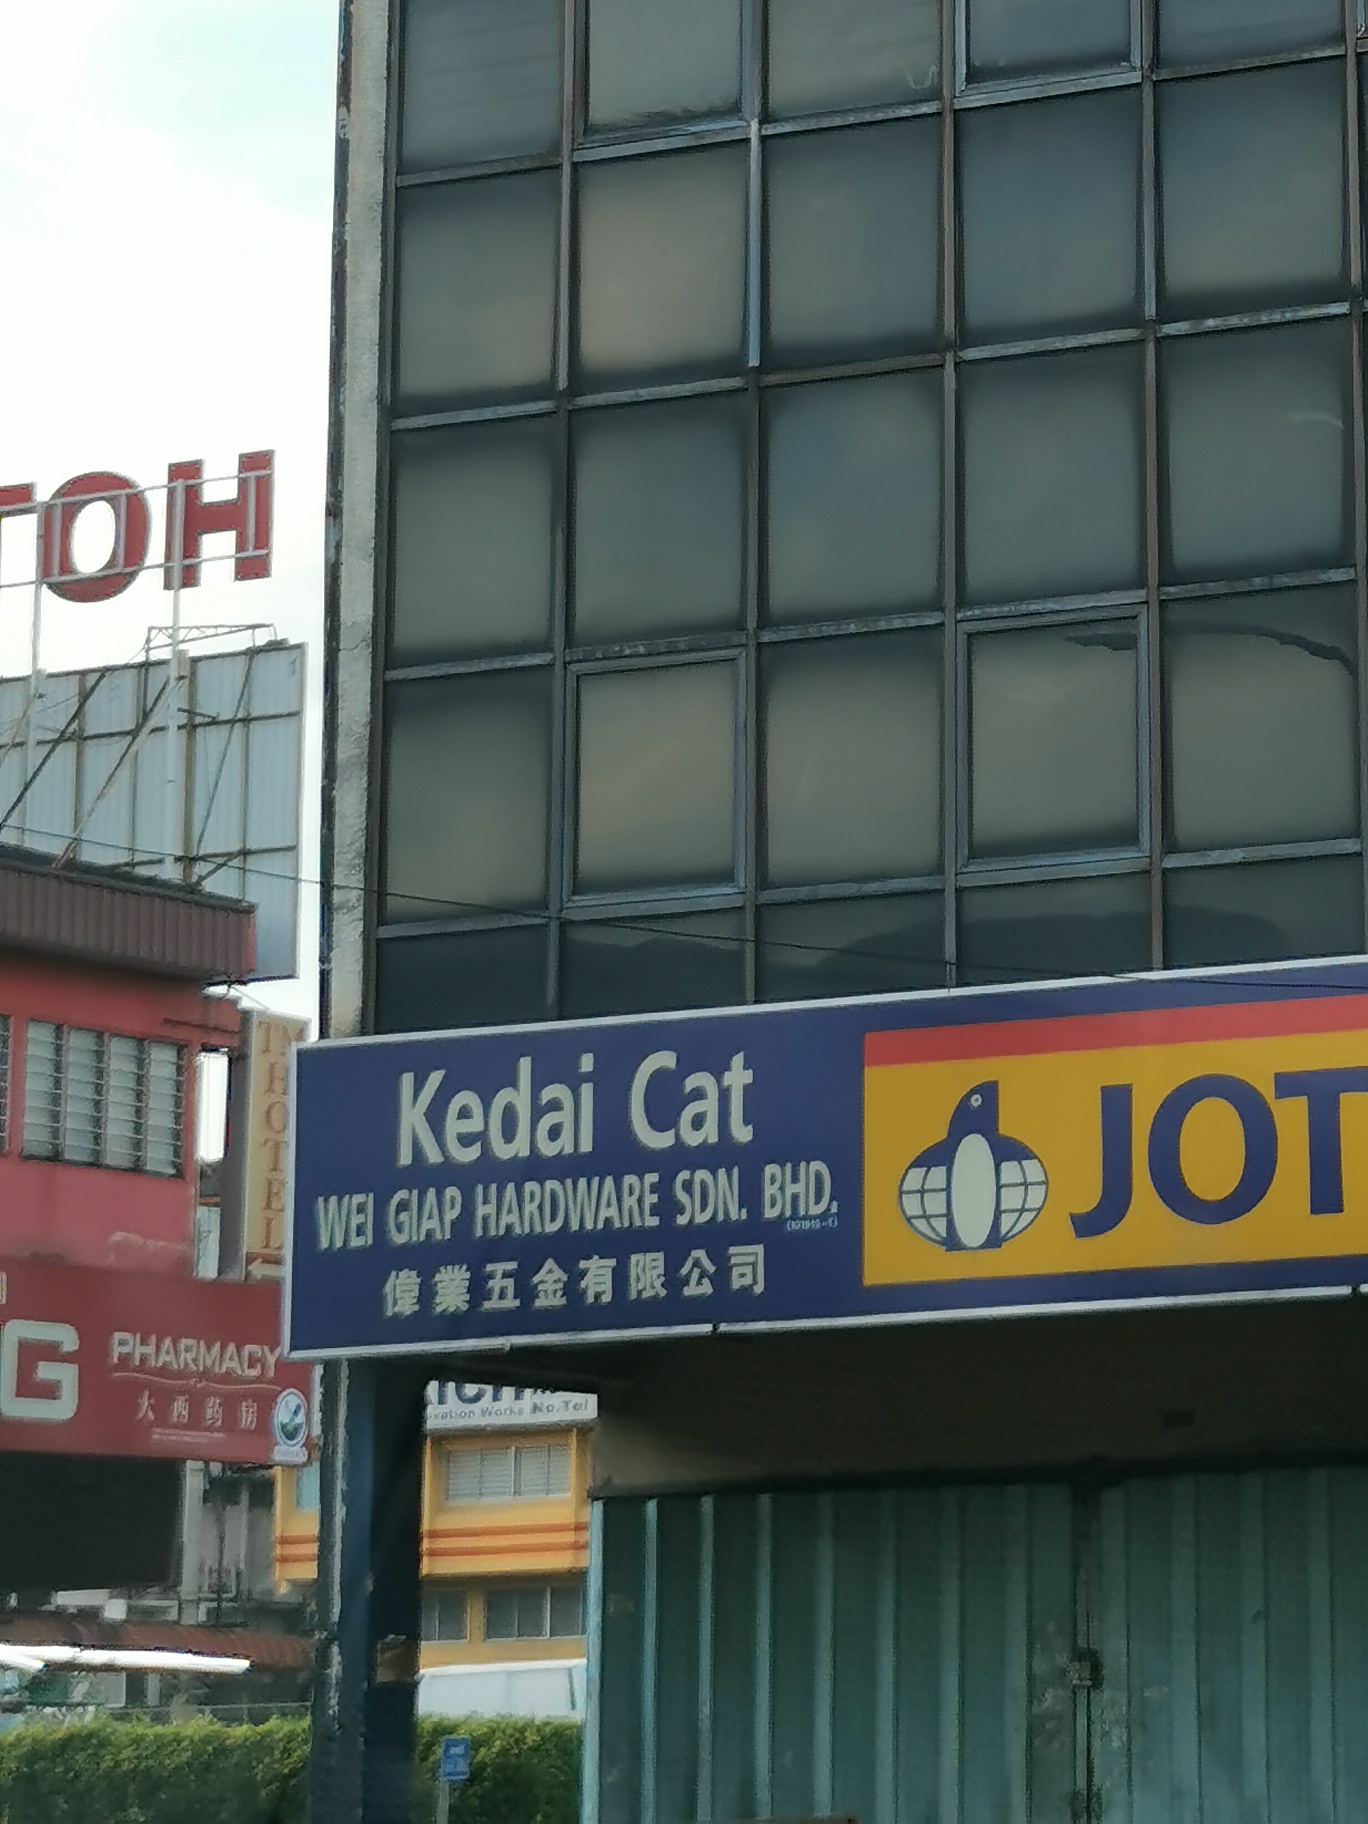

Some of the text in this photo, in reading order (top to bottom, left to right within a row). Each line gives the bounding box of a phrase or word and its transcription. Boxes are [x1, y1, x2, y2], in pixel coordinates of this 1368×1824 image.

[398, 1049, 756, 1166] Kedai Cat
[316, 1158, 839, 1251] WEI GIAP HARDWARE SDN. BHD.
[382, 1242, 767, 1320] 偉業五金有限公司
[112, 1331, 282, 1378] PHARMACY
